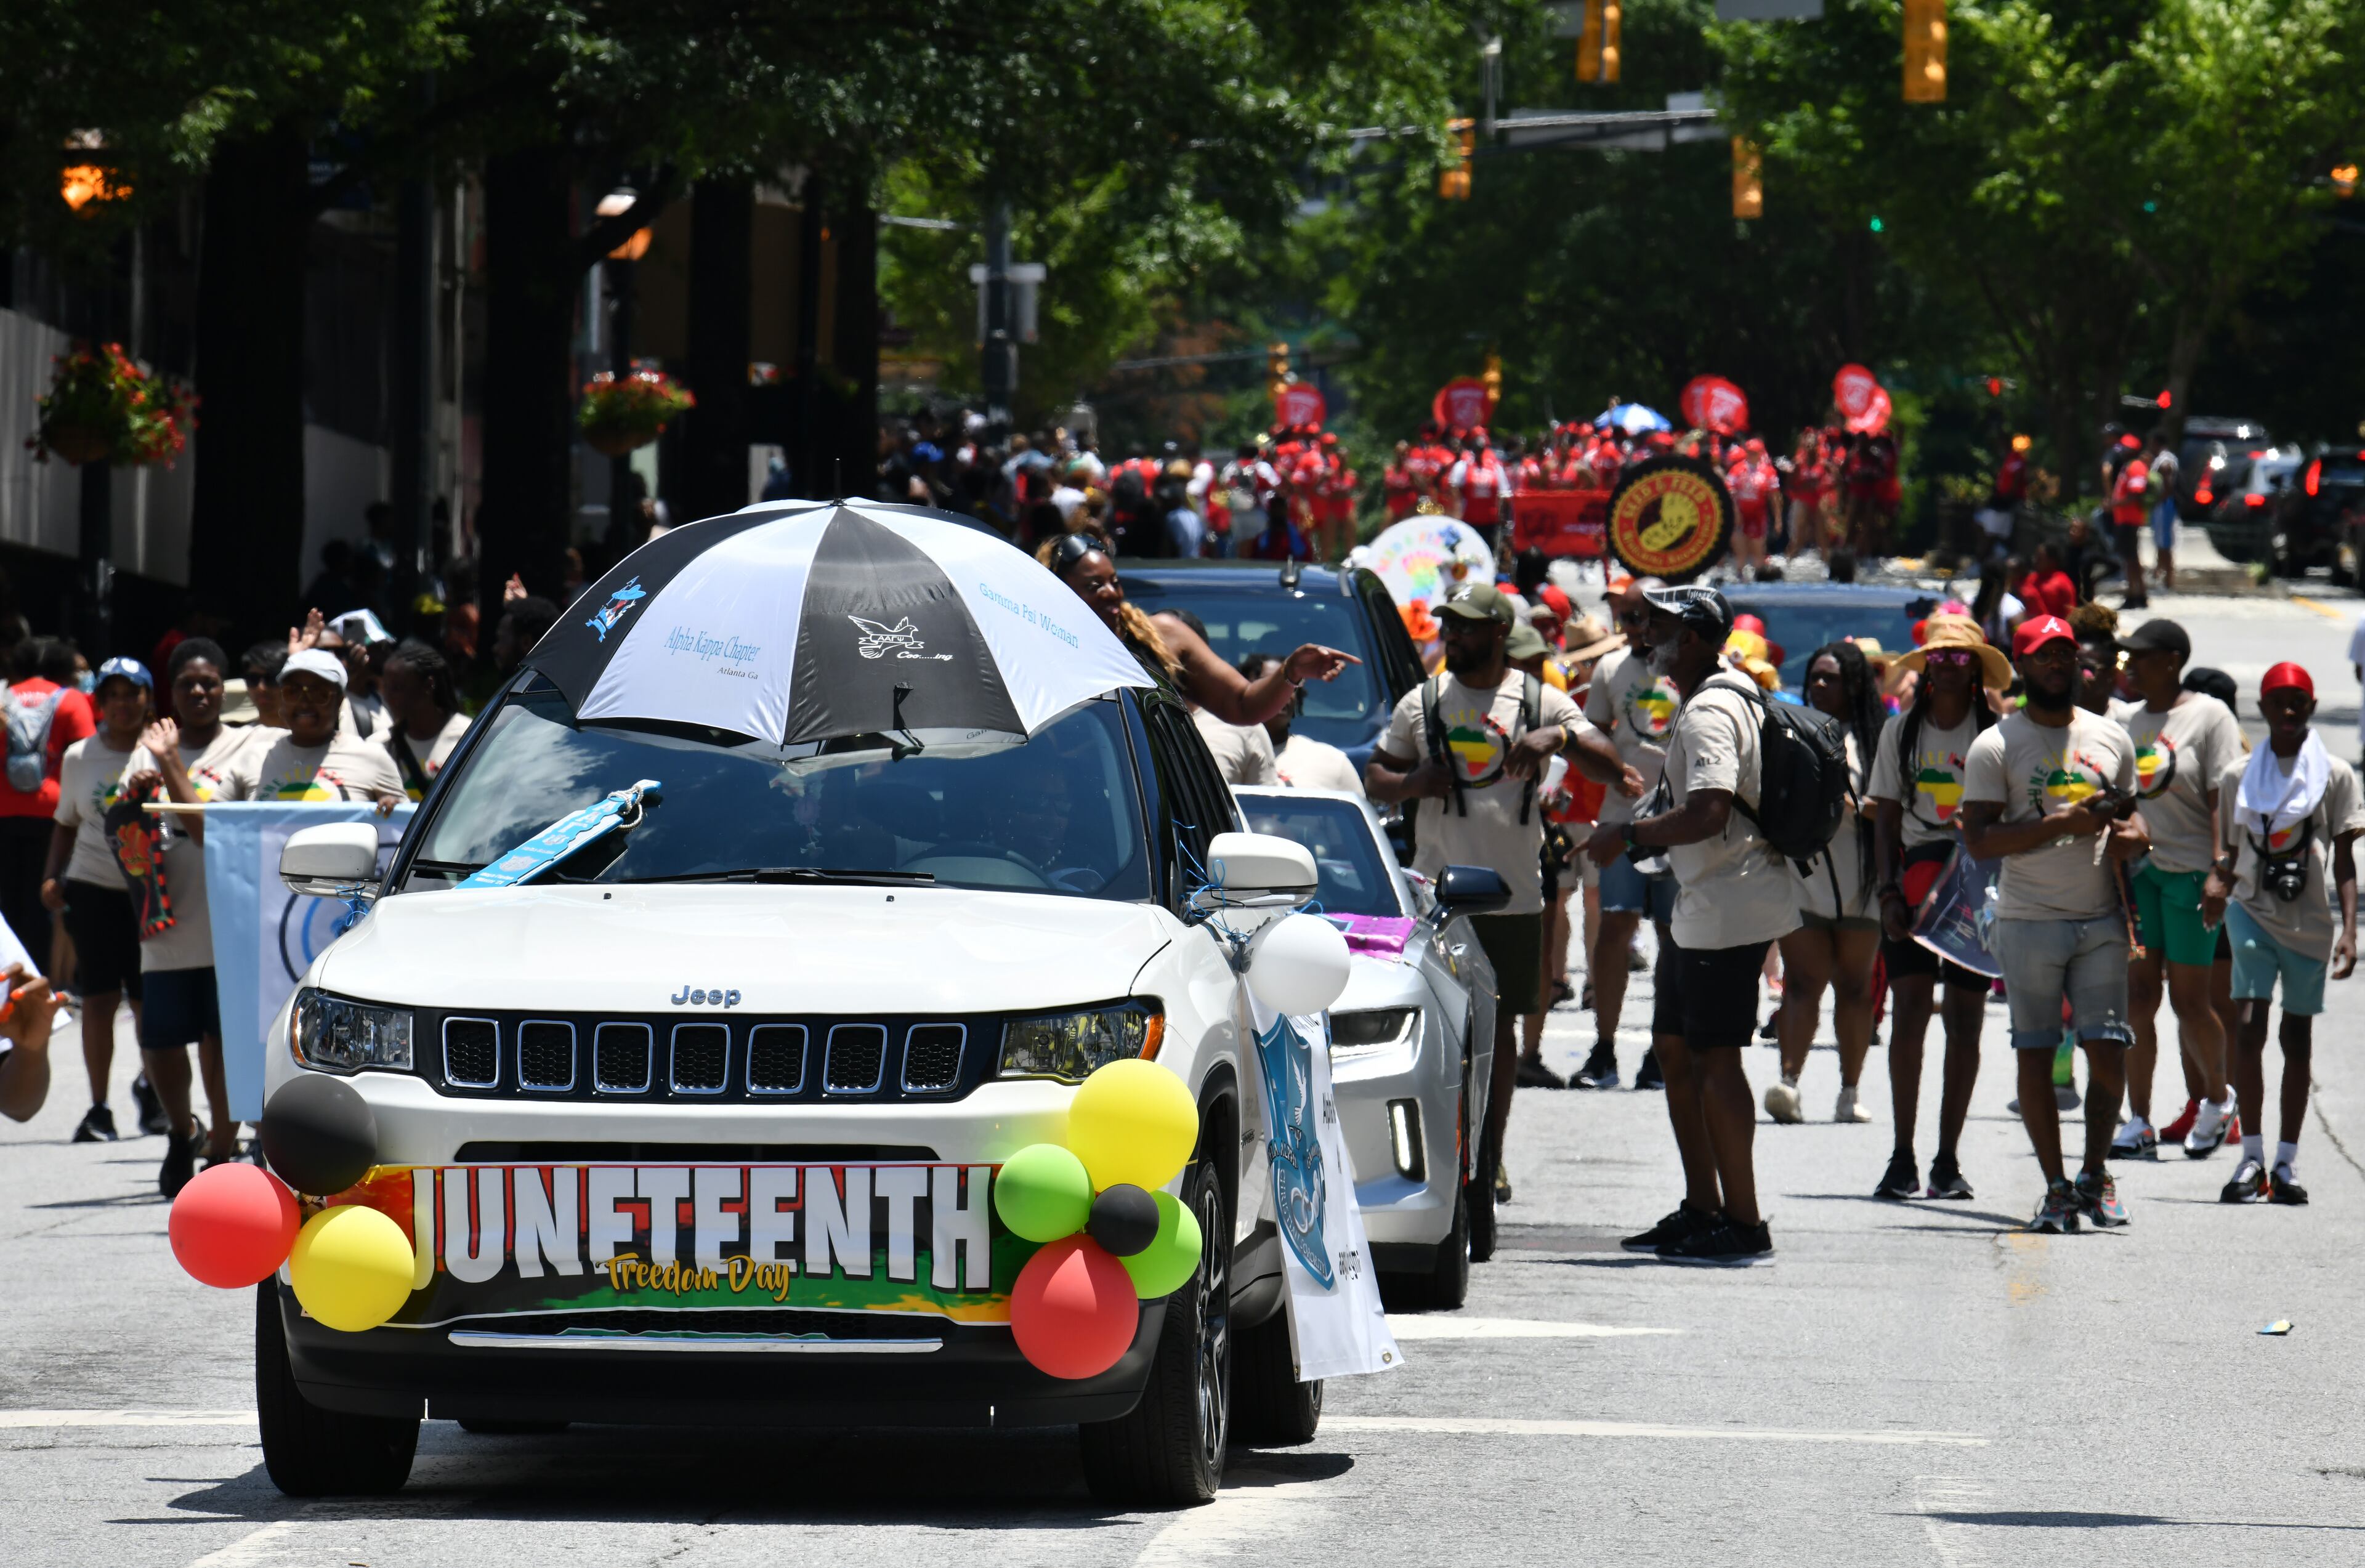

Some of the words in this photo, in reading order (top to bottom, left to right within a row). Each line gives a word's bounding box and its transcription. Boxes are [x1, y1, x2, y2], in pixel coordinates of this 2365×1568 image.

[979, 583, 1020, 615] Gamma
[1022, 604, 1037, 624] Psi
[1040, 613, 1078, 649] Woman
[664, 626, 694, 655] Alpha
[693, 631, 724, 661] Kappa
[724, 636, 761, 666] Chapter
[717, 667, 746, 677] Atlanta
[748, 671, 759, 680] Ga
[671, 985, 742, 1009] Jeep
[411, 1166, 992, 1291] JUNETEENTH
[596, 1251, 719, 1297] Freedom
[720, 1254, 790, 1303] Day
